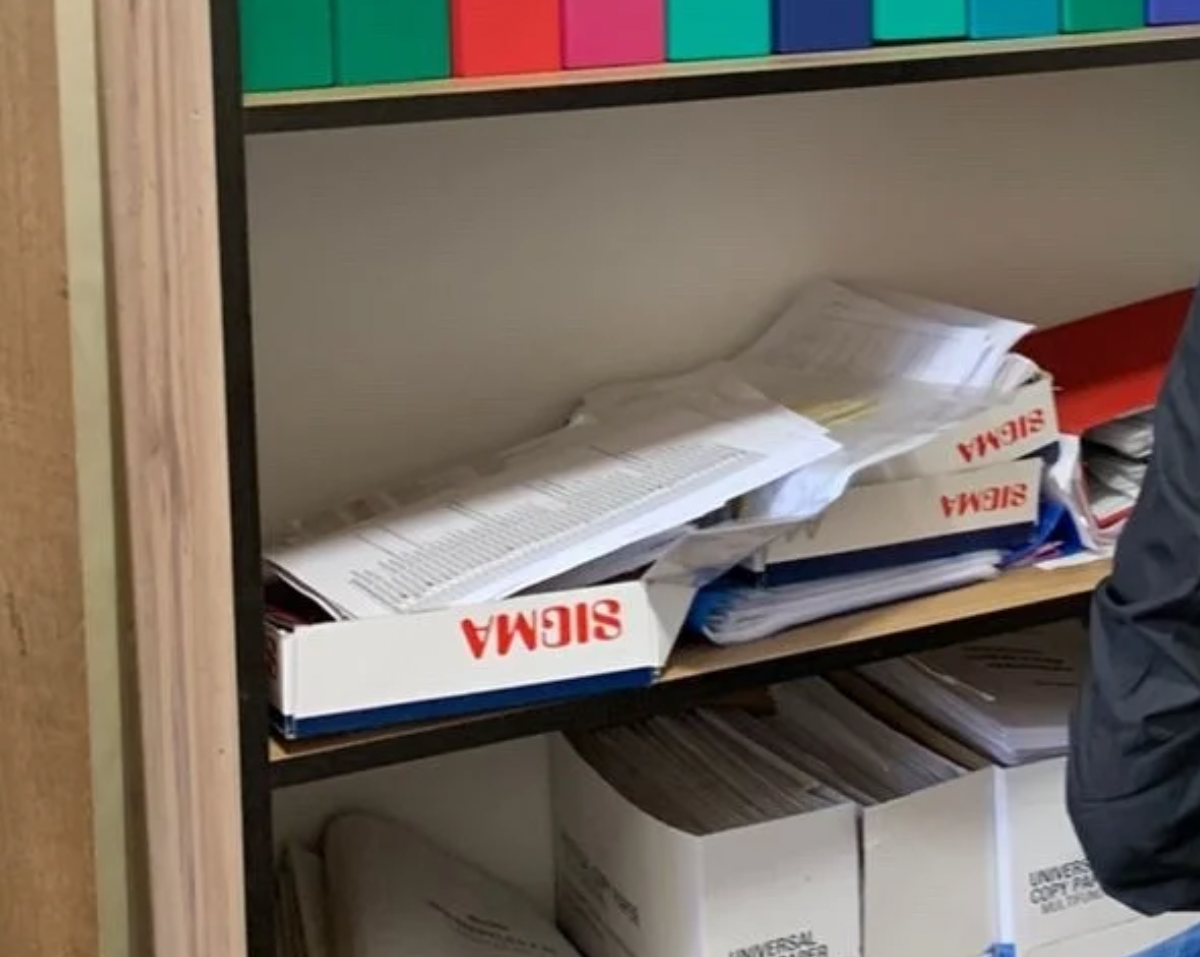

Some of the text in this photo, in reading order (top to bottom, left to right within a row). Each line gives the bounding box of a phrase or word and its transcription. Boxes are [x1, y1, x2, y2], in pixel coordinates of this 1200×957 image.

[957, 408, 1045, 462] SIGMA
[940, 483, 1029, 518] SIGMA
[460, 598, 622, 659] SIGMA
[1028, 858, 1091, 886] UNIVERS
